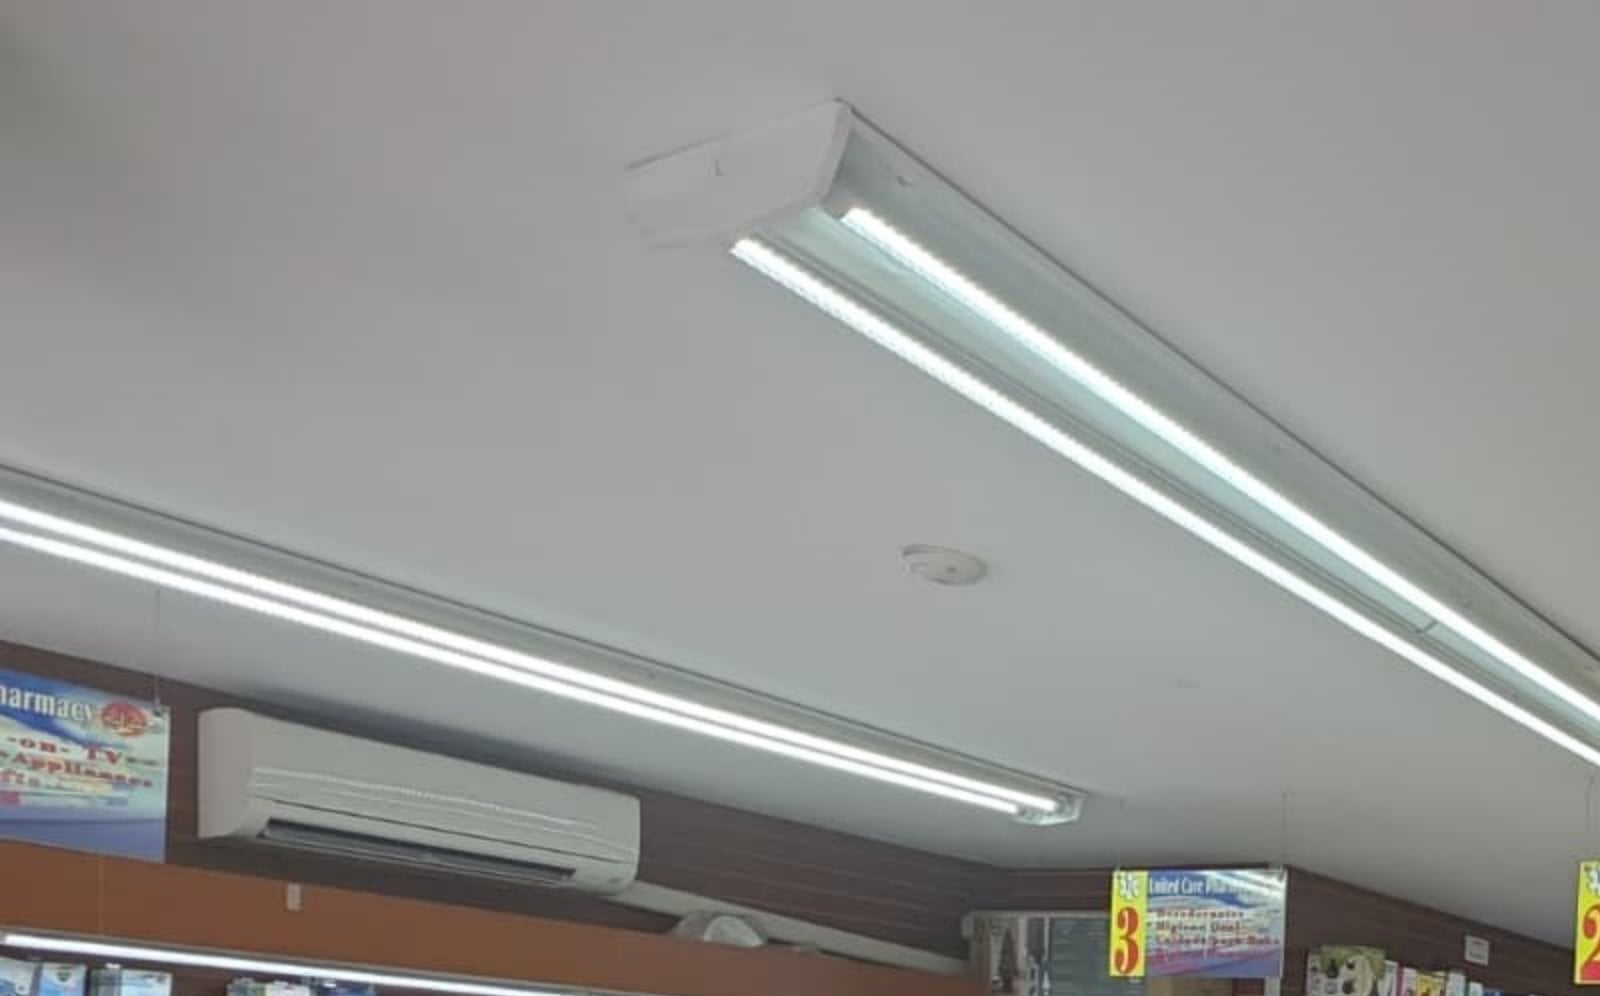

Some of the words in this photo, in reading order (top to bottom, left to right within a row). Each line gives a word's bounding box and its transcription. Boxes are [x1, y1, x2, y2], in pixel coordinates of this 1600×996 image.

[1150, 877, 1179, 896] United
[1181, 877, 1204, 896] Care
[1114, 906, 1139, 974] 3
